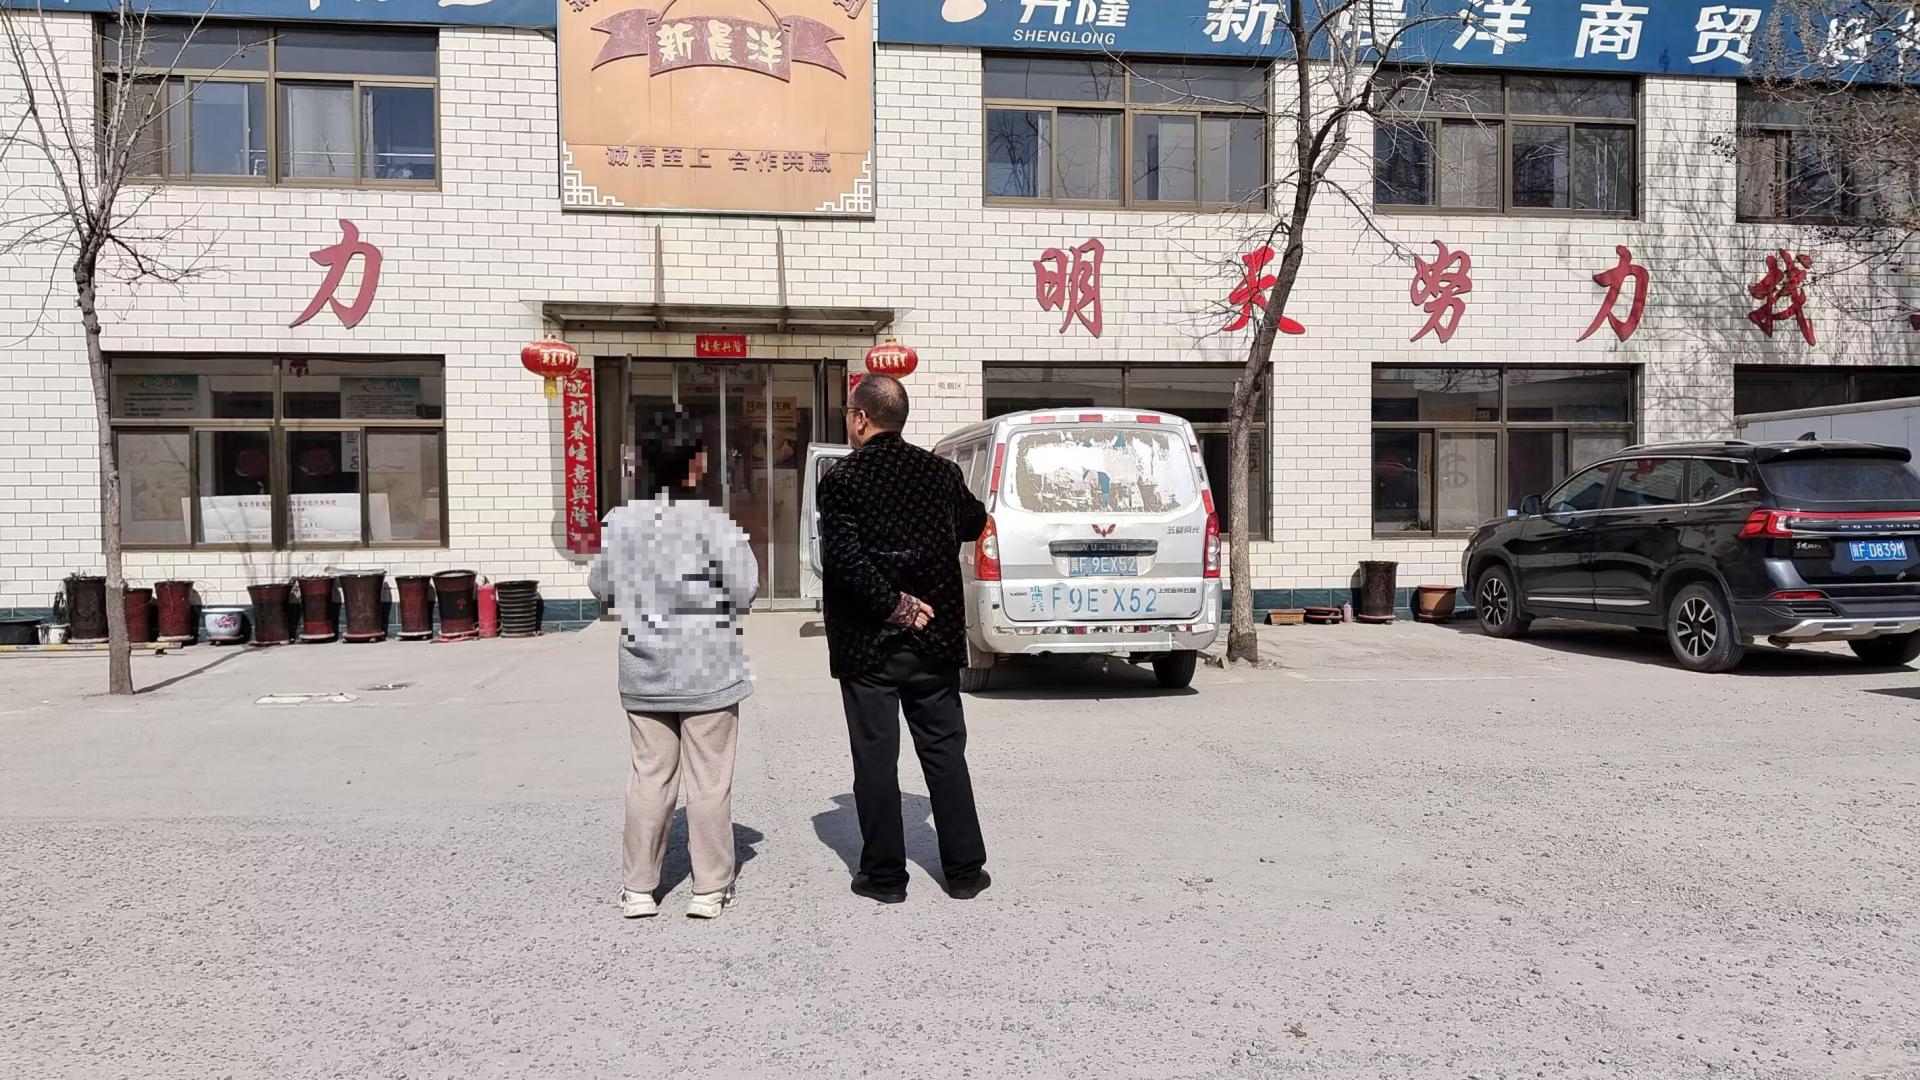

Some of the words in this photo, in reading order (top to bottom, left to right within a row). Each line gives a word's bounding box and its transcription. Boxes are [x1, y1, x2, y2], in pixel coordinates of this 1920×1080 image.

[656, 19, 784, 72] 新晨洋
[1013, 29, 1116, 45] SHENGLONG
[605, 145, 712, 170] 诚信至上
[728, 151, 832, 172] 合作共赢
[289, 219, 383, 329] 力
[1080, 543, 1128, 551] WULING
